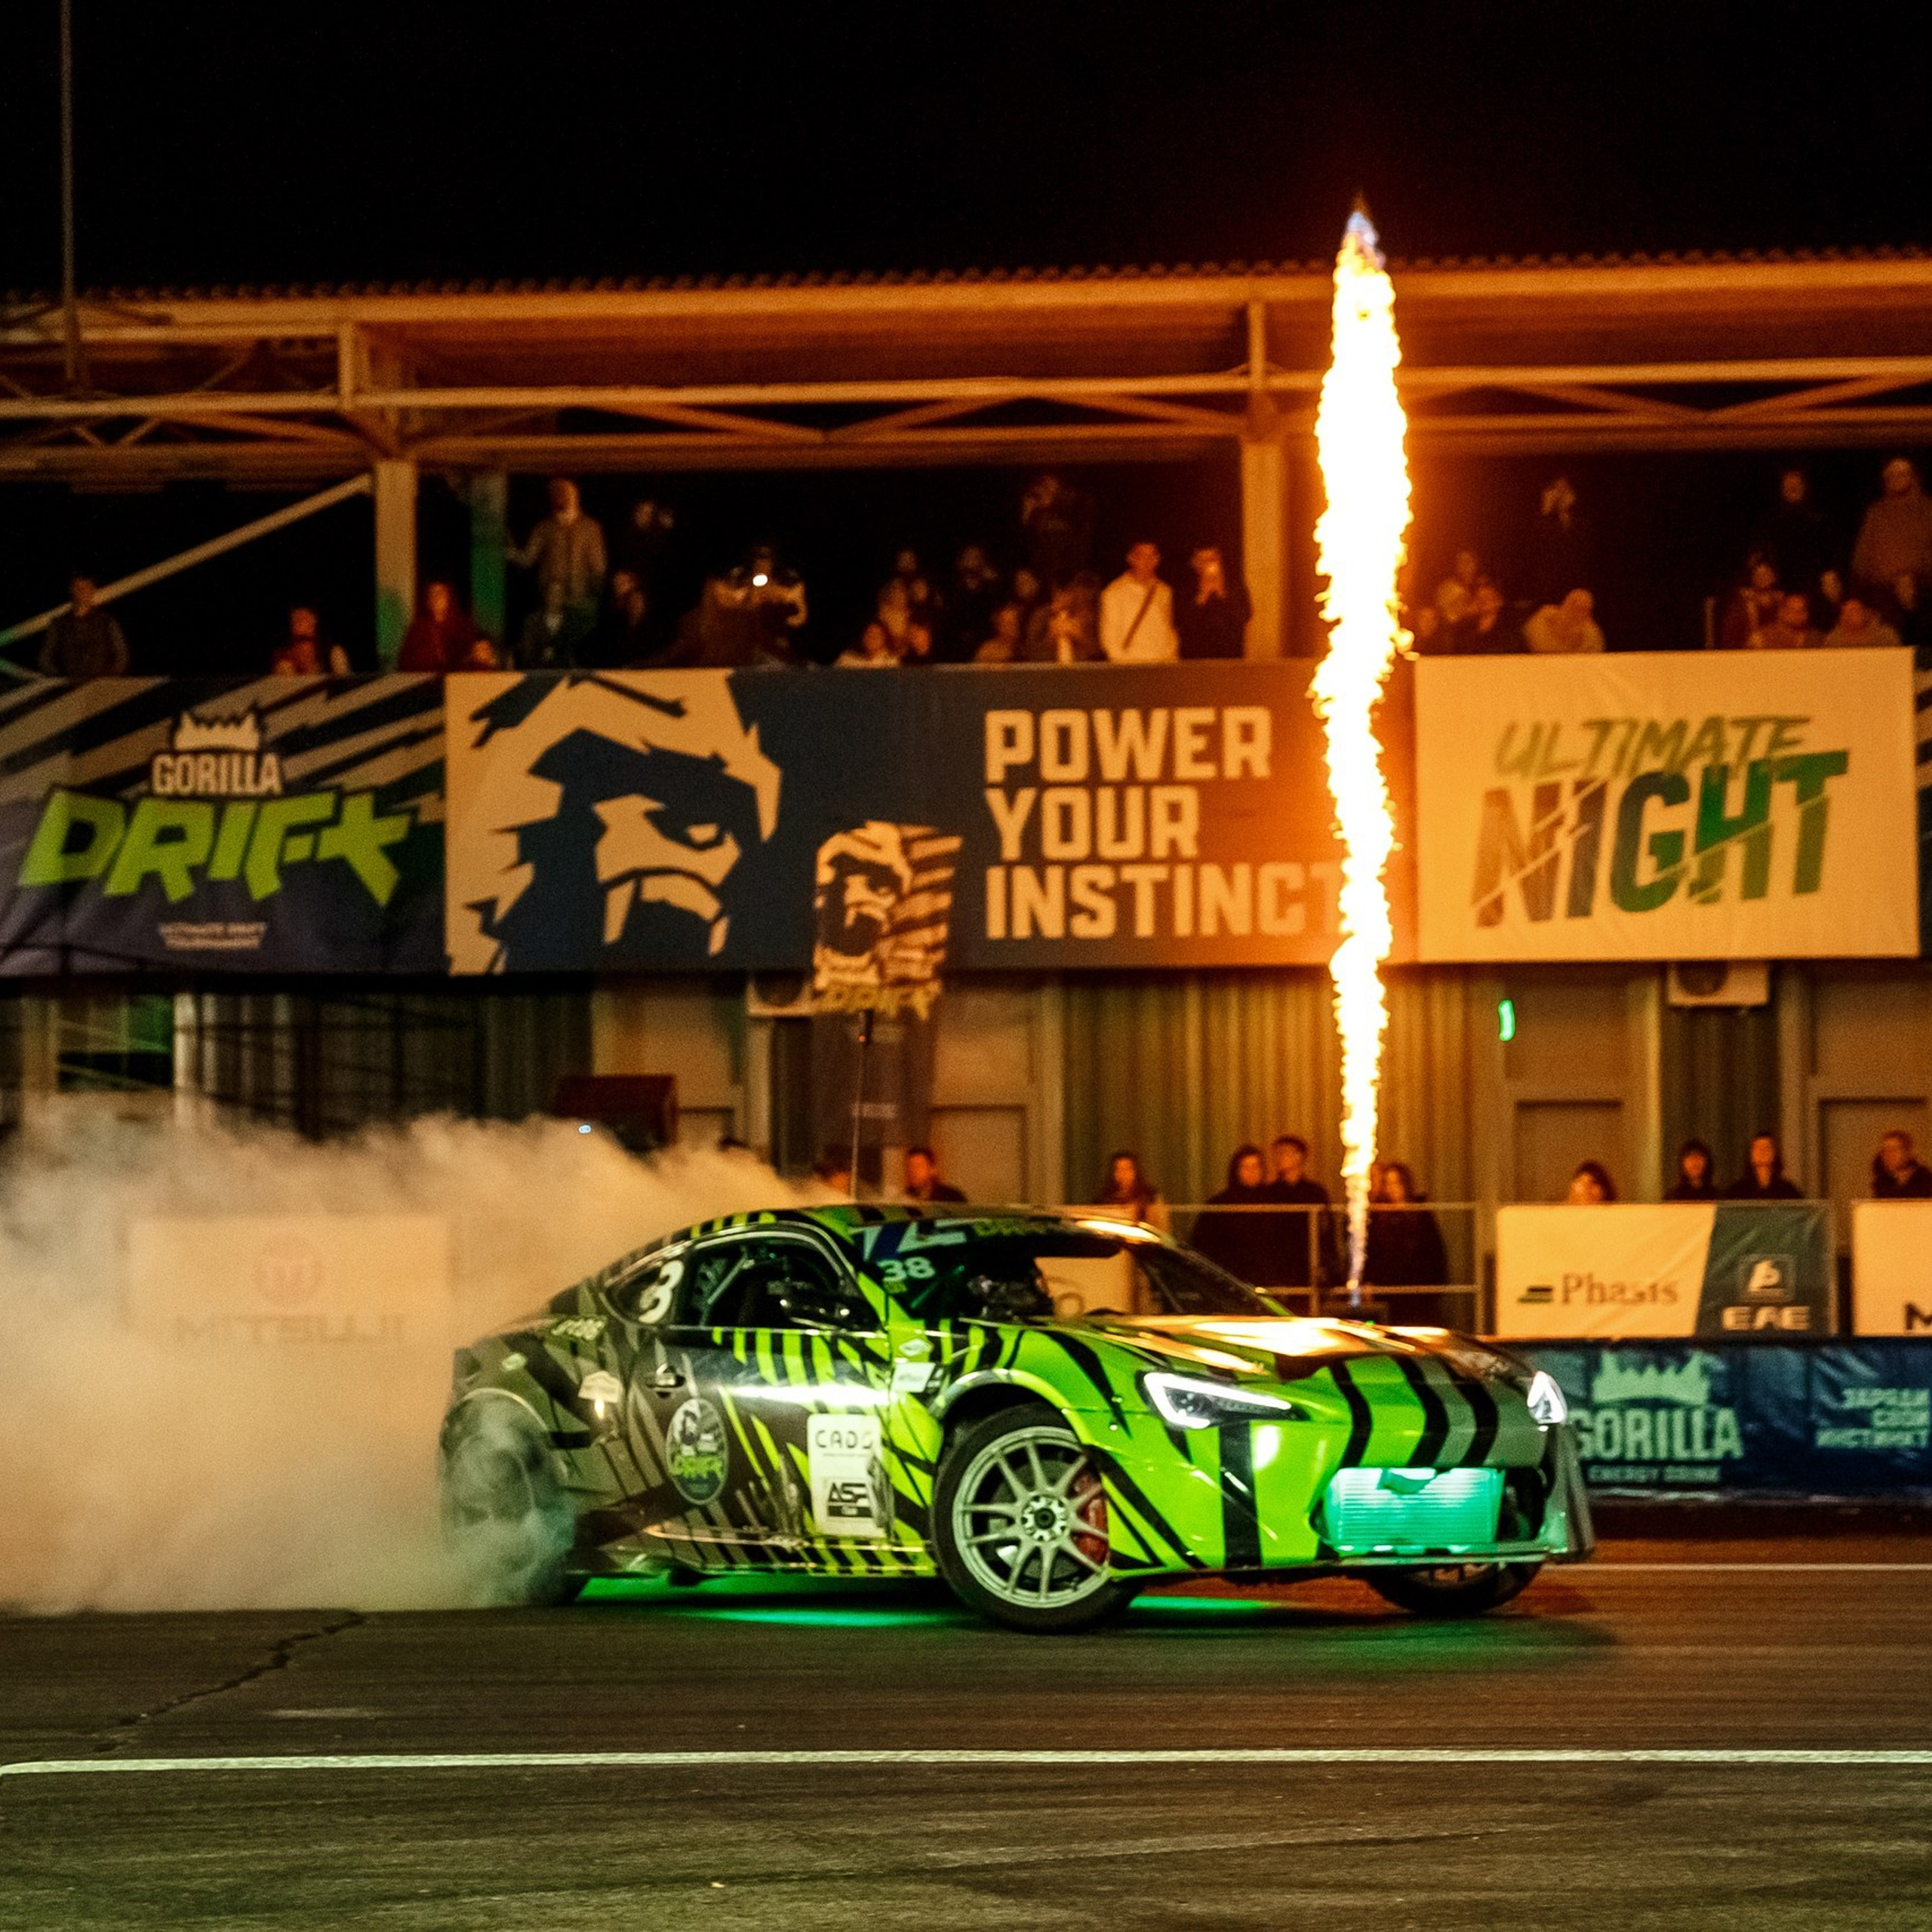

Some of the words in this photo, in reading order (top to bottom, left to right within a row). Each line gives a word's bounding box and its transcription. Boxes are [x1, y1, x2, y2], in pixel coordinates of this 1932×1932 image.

[152, 753, 282, 796] GORILLA
[984, 706, 1271, 783] POWER
[1495, 715, 1811, 780] ULTIMATE
[18, 791, 411, 907] DRIFT
[984, 786, 1200, 861] YOUR
[1471, 749, 1850, 928] NIGHT
[984, 863, 1345, 940] INSTINCT
[875, 1256, 935, 1283] 38
[1567, 1409, 1744, 1460] GORILLA
